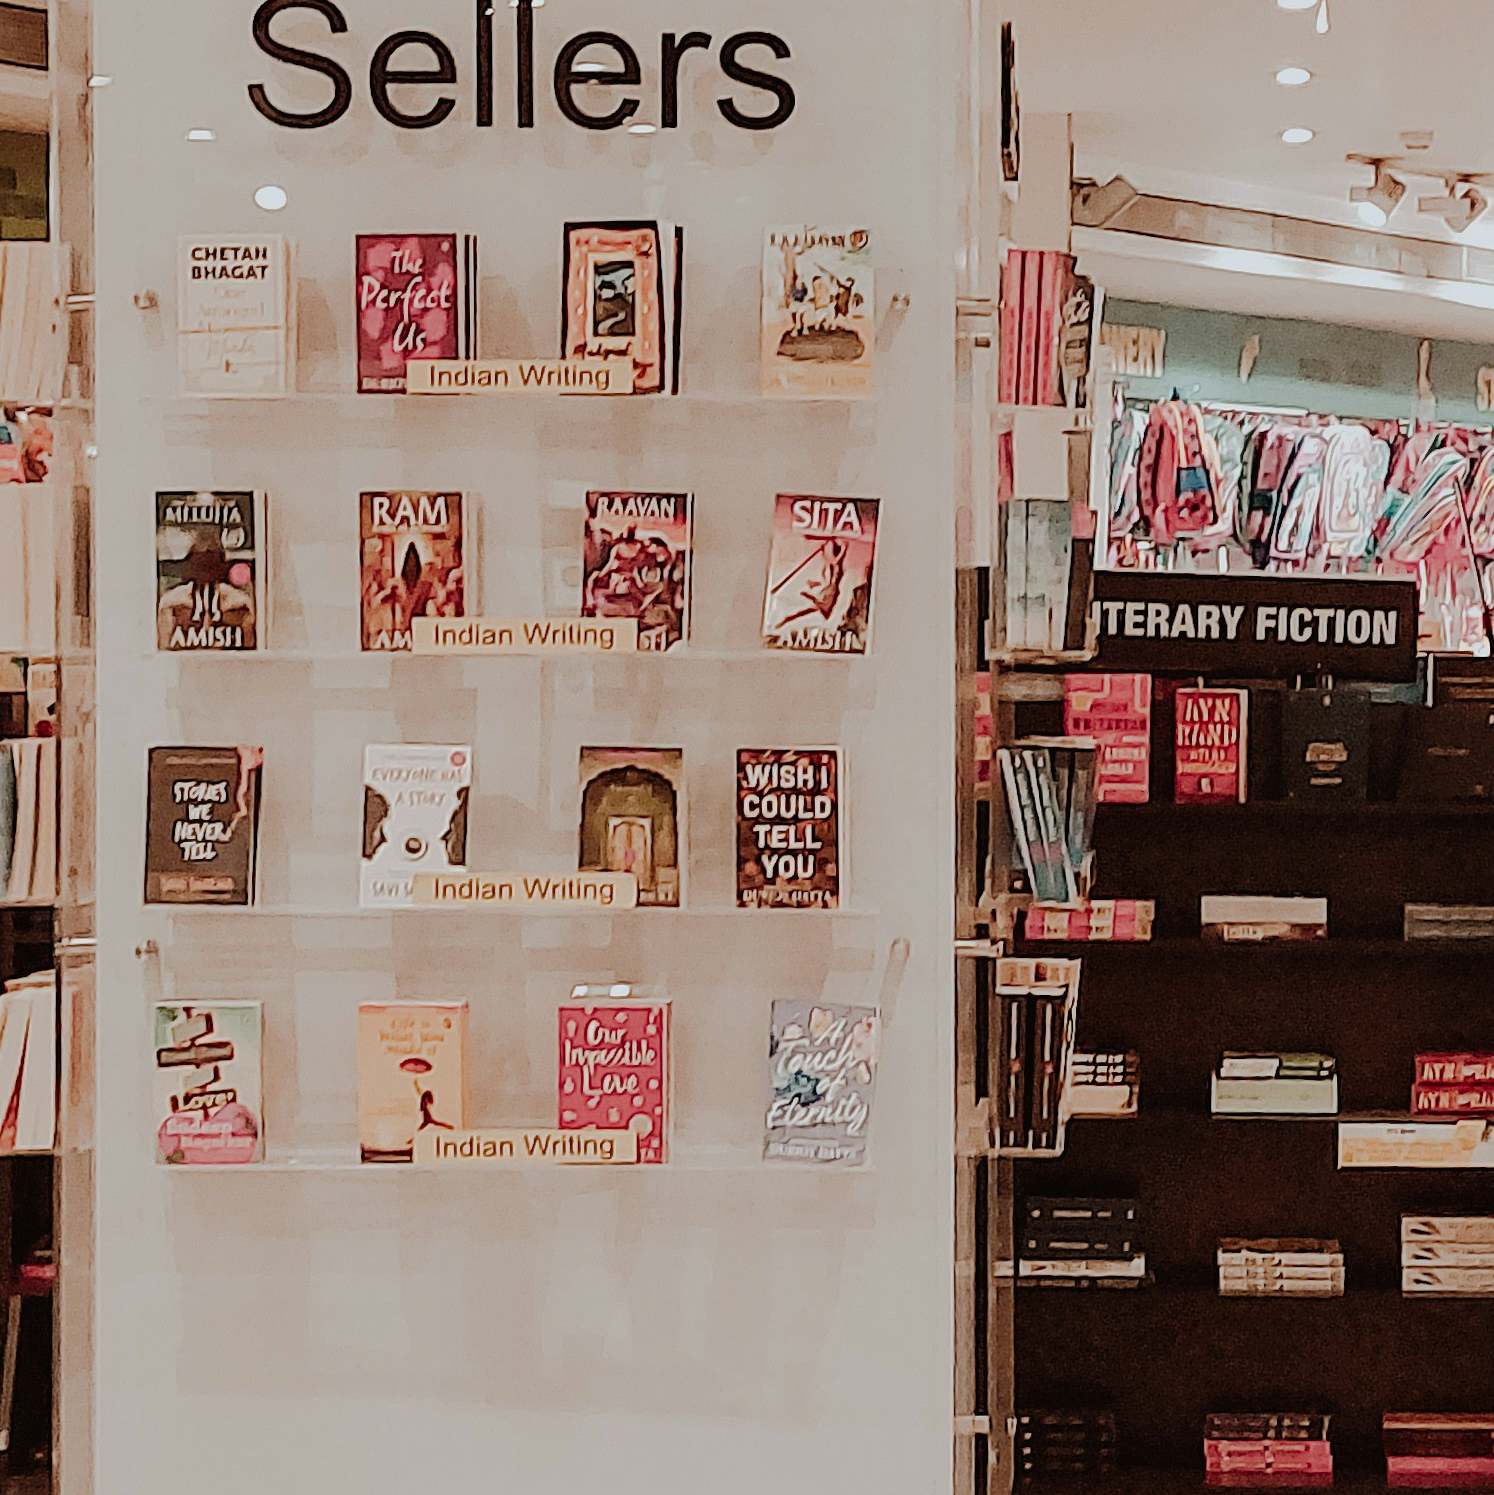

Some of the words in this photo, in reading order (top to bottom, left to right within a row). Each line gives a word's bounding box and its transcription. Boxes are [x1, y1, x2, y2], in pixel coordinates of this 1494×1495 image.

[191, 246, 266, 262] CHETAN
[392, 250, 423, 275] The
[191, 265, 270, 280] BHAGAT
[361, 275, 452, 323] Perfect
[393, 322, 426, 352] Us
[430, 364, 510, 388] Indian
[520, 364, 610, 393] Writing
[372, 496, 448, 524] RAM
[597, 497, 676, 520] RAAVAN
[792, 501, 863, 530] SITA
[170, 626, 242, 648] AMISH
[435, 623, 512, 647] Indian
[525, 622, 615, 653] Writing
[1256, 606, 1398, 645] FICTION
[745, 765, 815, 790] WISH
[743, 794, 832, 820] COULD
[753, 824, 822, 850] TELL
[762, 854, 815, 879] YOU
[435, 878, 512, 902] Indian
[523, 878, 615, 906] Writing
[586, 1020, 626, 1044] Our
[766, 1102, 868, 1137] Eternity
[436, 1135, 513, 1159] Indian
[525, 1135, 615, 1162] Writing
